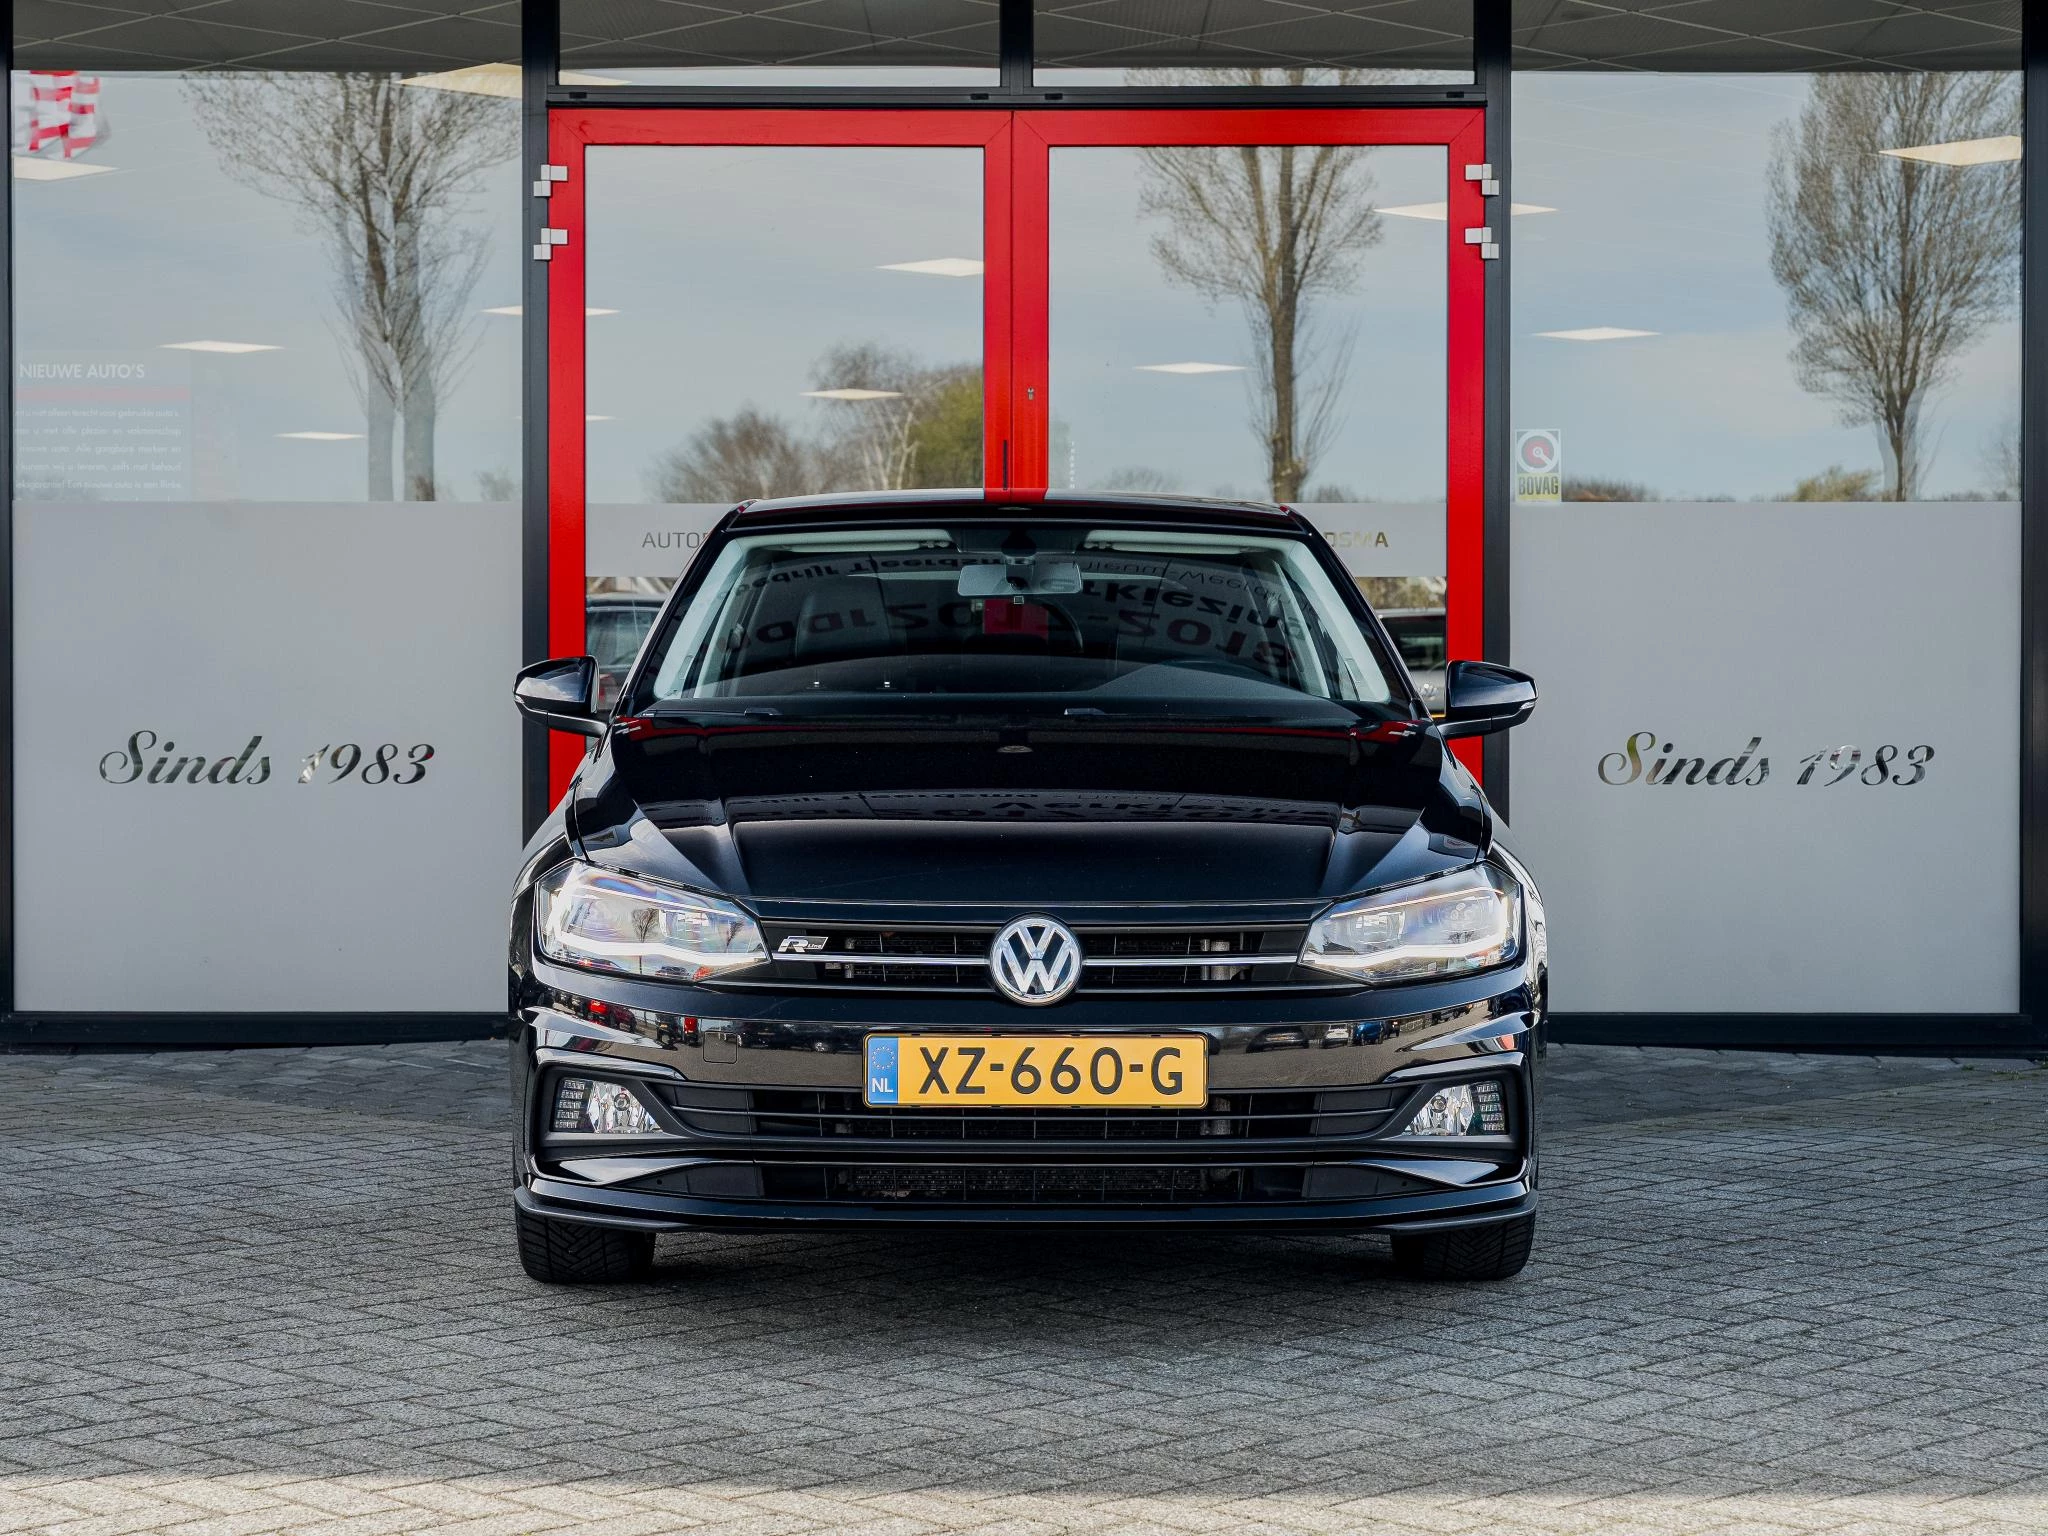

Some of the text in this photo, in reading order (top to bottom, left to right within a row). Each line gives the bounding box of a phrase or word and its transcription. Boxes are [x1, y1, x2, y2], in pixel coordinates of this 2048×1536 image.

[19, 363, 145, 378] NIEUWE AUTO'S
[1518, 476, 1559, 495] BOVAG
[641, 531, 709, 549] AUTO
[99, 730, 435, 785] Sinds 1983
[1598, 731, 1935, 787] Sinds 1983
[918, 1047, 1183, 1095] XZ-660-G
[872, 1078, 894, 1093] NL
